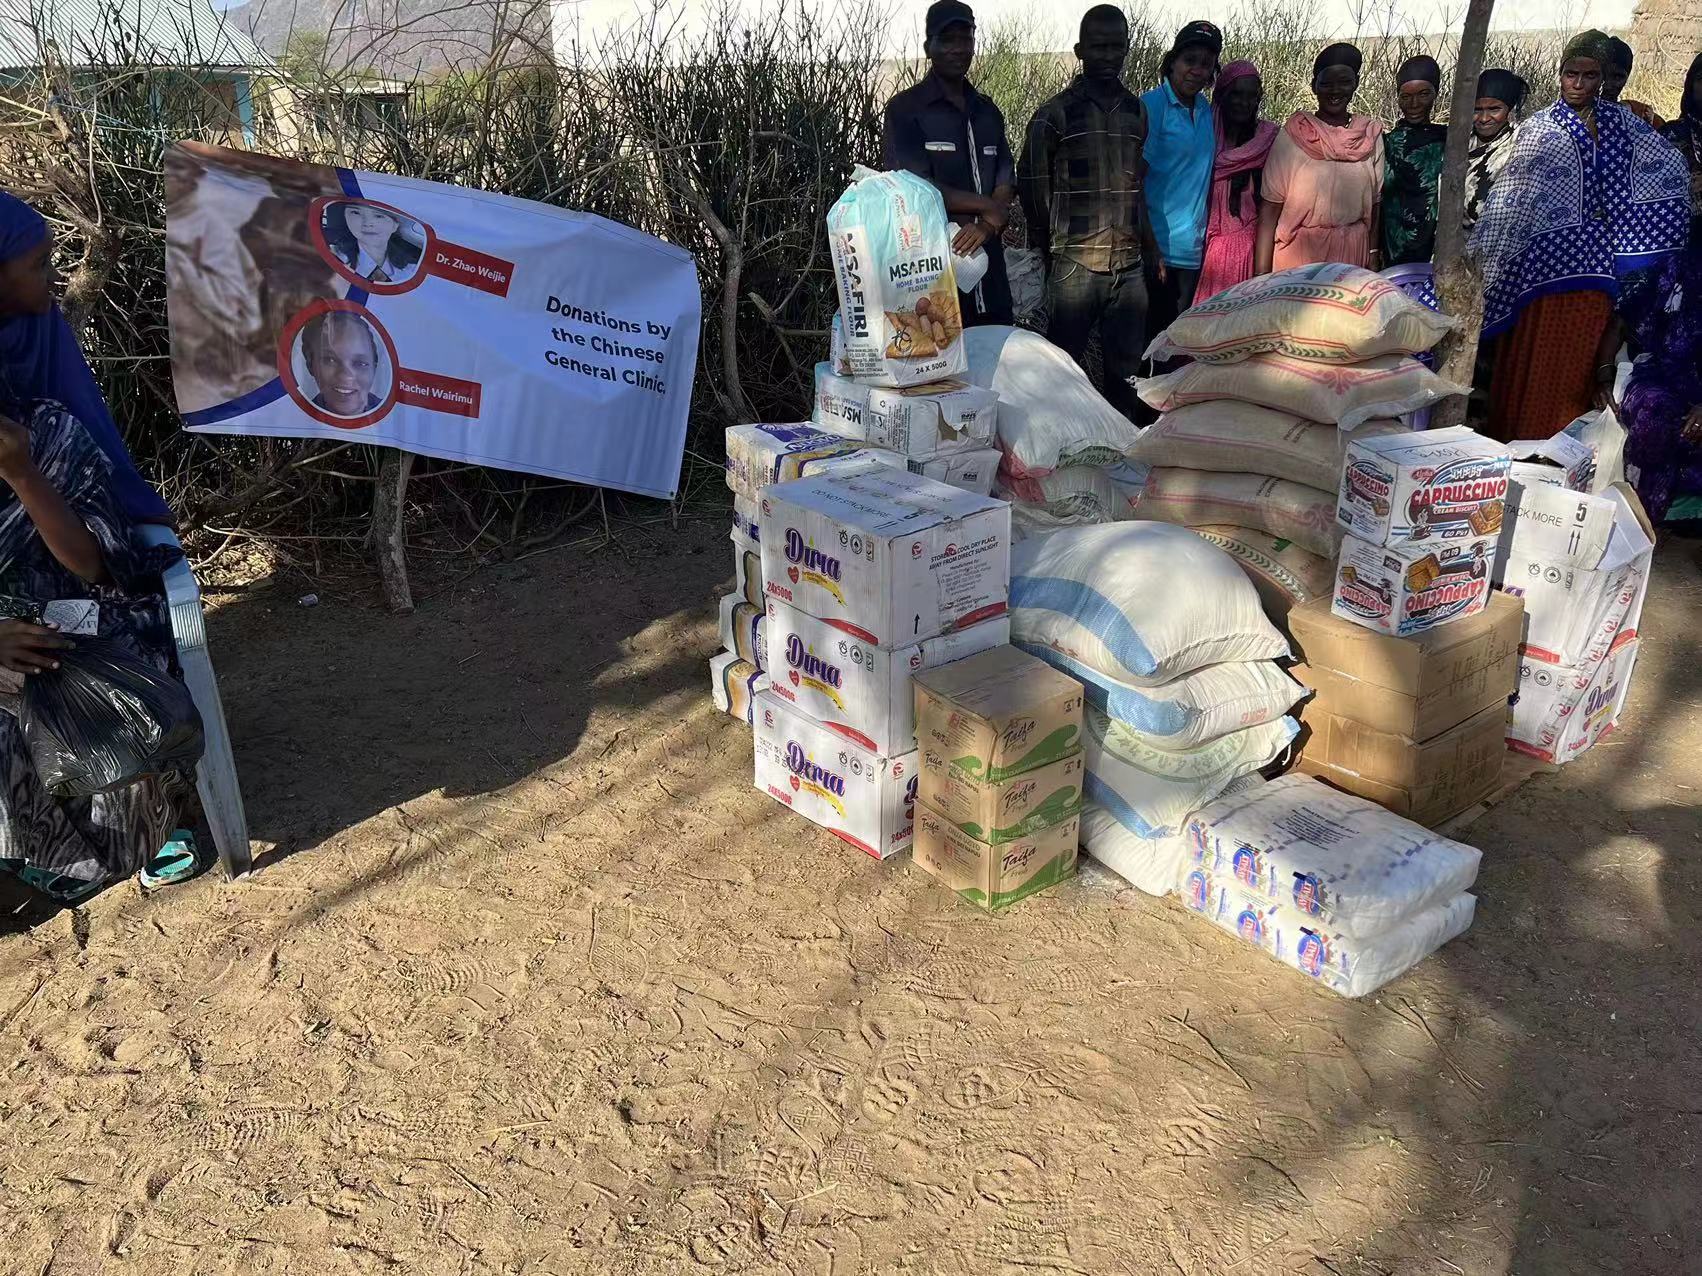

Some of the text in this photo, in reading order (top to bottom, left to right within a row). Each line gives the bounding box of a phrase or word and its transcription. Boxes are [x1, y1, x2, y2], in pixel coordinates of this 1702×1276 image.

[435, 253, 506, 283] Dr. Zhao Weijie
[889, 255, 943, 282] MSAFIRI
[839, 266, 852, 304] BAKING
[896, 274, 939, 288] HOME BAKING
[908, 284, 928, 293] FLOUR
[546, 295, 672, 341] Donations by
[551, 327, 665, 364] the Chinese
[544, 350, 617, 382] General
[915, 367, 924, 375] 24
[399, 381, 473, 405] Rachel Wairimu
[1410, 479, 1507, 506] CAPPUCCINO
[1433, 506, 1455, 515] CREAM
[1531, 511, 1564, 528] MORE
[1575, 502, 1588, 523] 5
[942, 556, 958, 567] FROM
[957, 550, 976, 561] DIRECT
[975, 542, 1000, 556] SUNLIGHT
[970, 541, 982, 551] DRY
[981, 535, 997, 545] PLACE
[1339, 585, 1393, 617] CAPPUCCINO
[1405, 578, 1487, 612] CAPPUCCINO
[1003, 720, 1036, 749] Taifa
[925, 752, 942, 771] Taifa
[1004, 782, 1037, 809] Taifa
[921, 817, 941, 836] Taifa
[1002, 847, 1037, 872] Taifa
